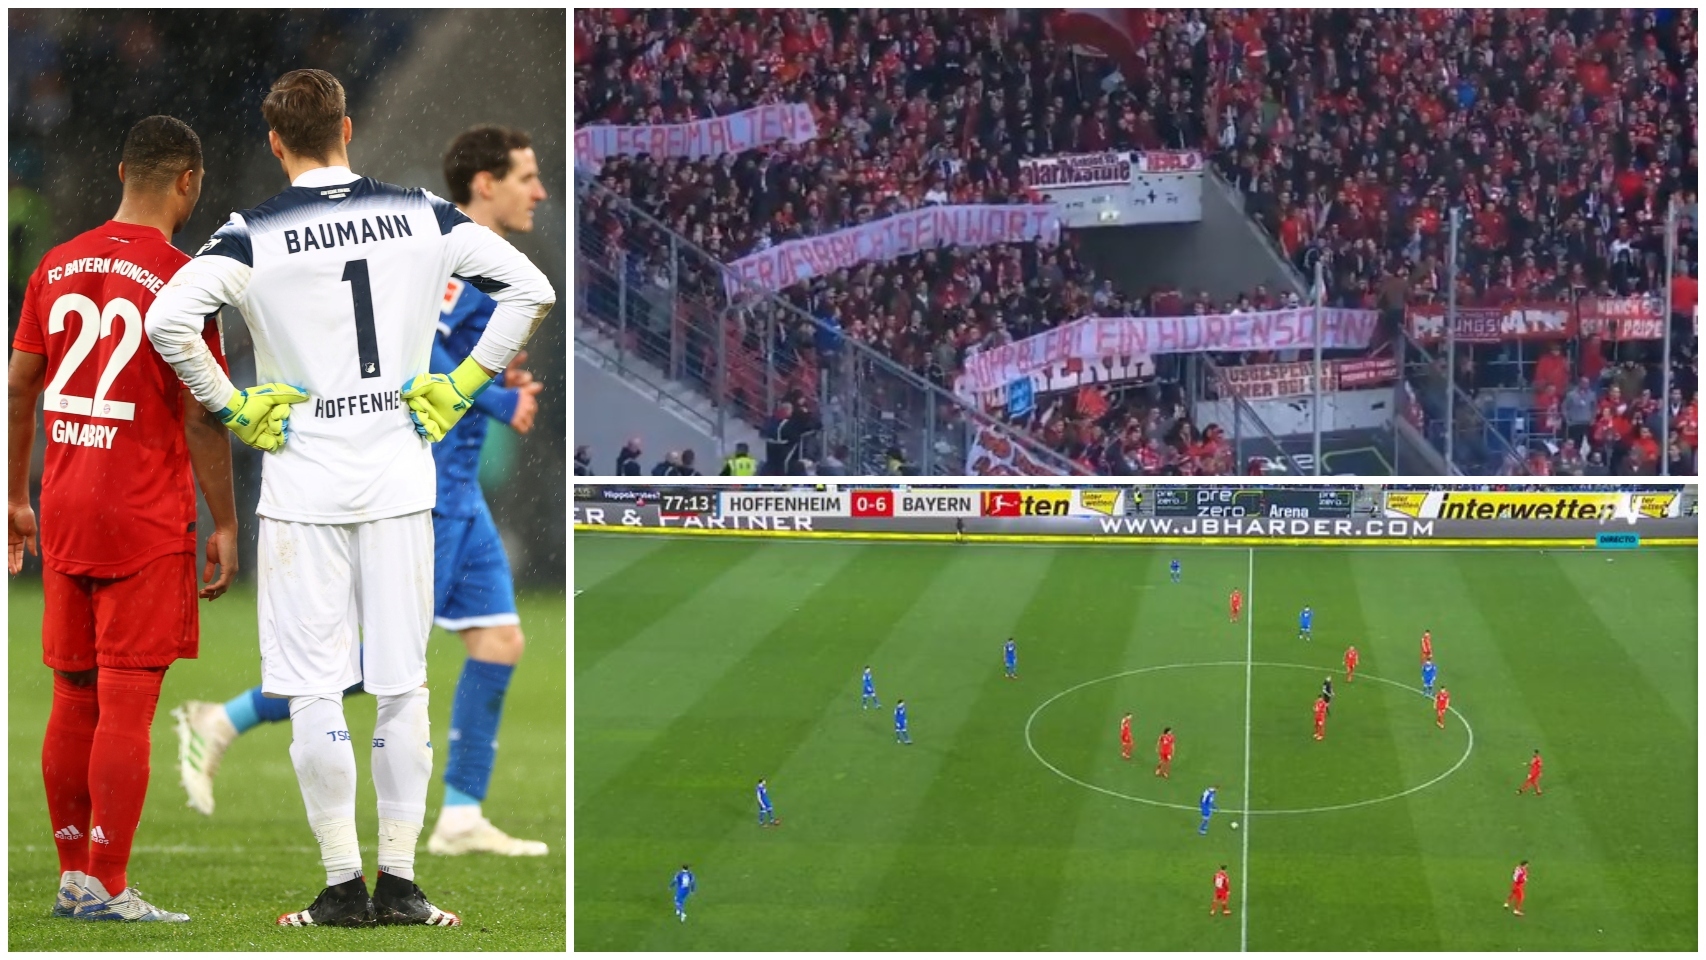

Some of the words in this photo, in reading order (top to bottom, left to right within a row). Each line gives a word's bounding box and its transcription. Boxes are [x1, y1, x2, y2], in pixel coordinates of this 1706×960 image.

[284, 214, 413, 254] BAUMANN
[48, 266, 63, 285] FC
[64, 257, 112, 277] BAYERN
[341, 259, 380, 378] 1
[43, 293, 143, 421] 22
[52, 419, 118, 449] GNABRY
[1197, 490, 1232, 505] pre
[1197, 506, 1245, 517] zero
[1269, 504, 1309, 518] Arena
[621, 508, 643, 526] &
[1101, 518, 1434, 536] WWW.JBHARDER.COM
